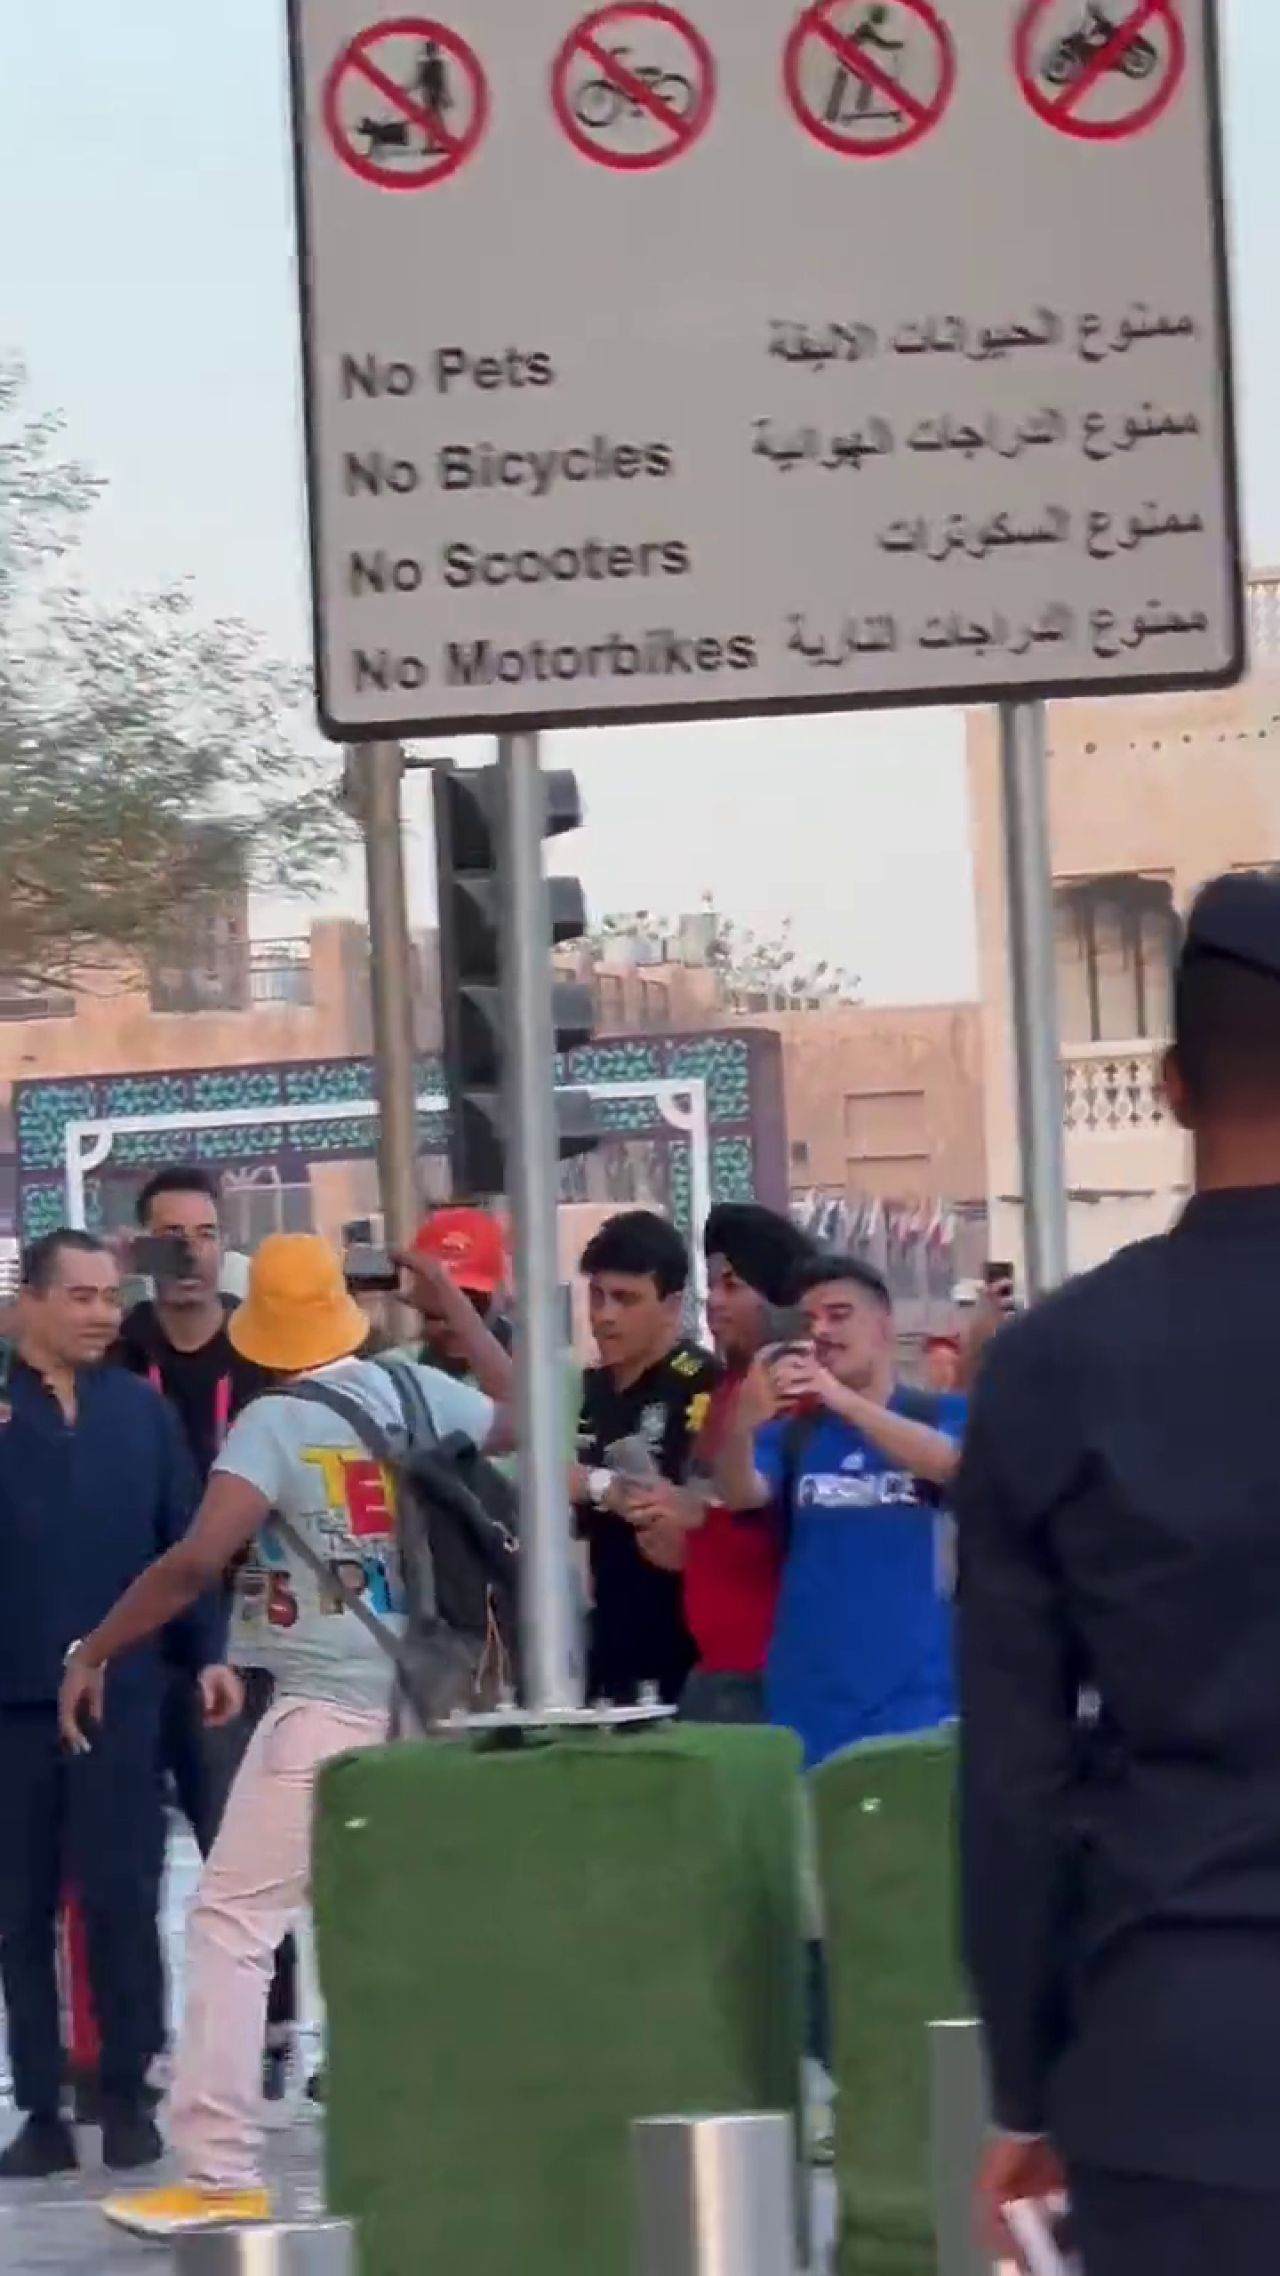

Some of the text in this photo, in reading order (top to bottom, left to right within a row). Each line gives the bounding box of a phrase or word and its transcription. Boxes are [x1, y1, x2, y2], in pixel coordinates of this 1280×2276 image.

[892, 305, 1064, 362] الحيوانات
[1078, 303, 1196, 362] ممنوع
[340, 346, 556, 400] No Pets
[906, 407, 1068, 460] الدراجات
[1082, 402, 1201, 461] ممنوع
[344, 434, 675, 497] No Bicycles
[877, 501, 1205, 562] ممنوع السكوترات
[349, 538, 692, 597] No Scooters
[352, 630, 758, 693] No Motorbikes
[786, 599, 1210, 668] ممنوع الدراجات النارية
